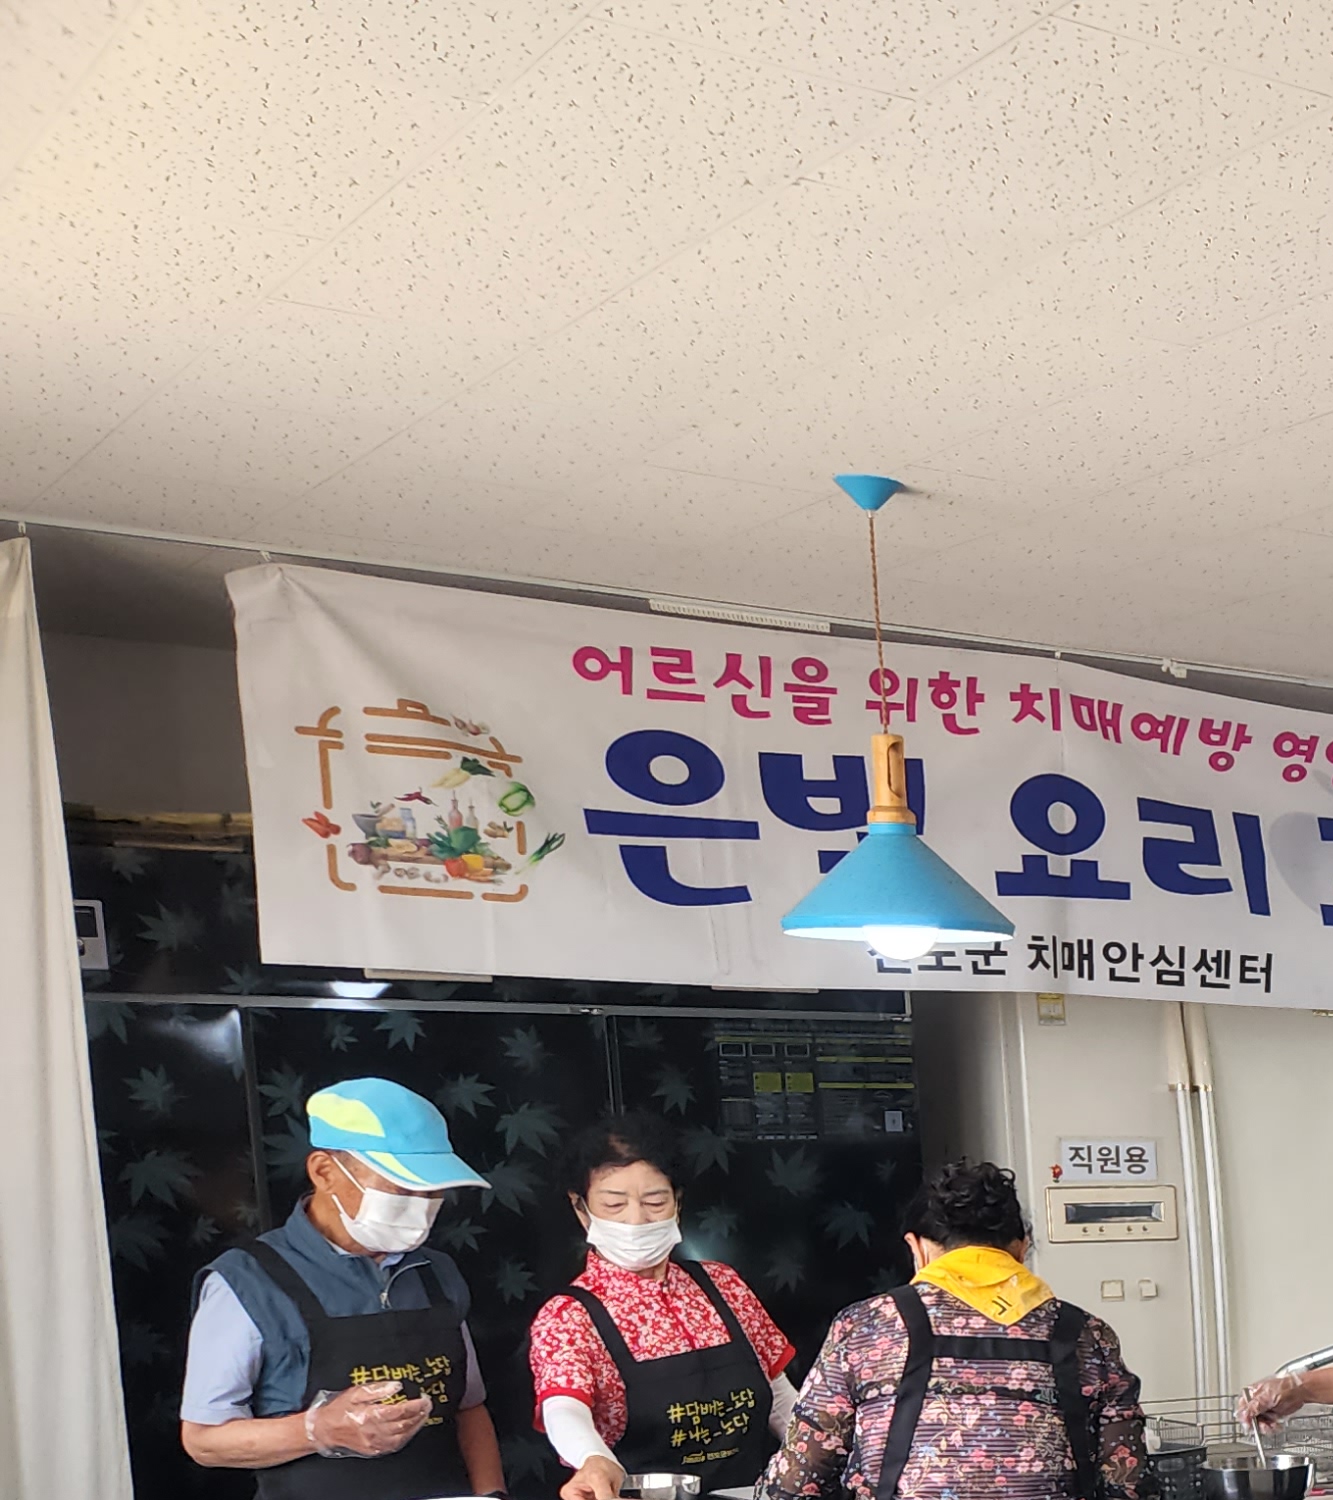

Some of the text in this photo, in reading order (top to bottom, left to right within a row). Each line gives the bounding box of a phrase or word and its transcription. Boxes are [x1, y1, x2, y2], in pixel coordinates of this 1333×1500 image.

[572, 645, 838, 726] 어르신을
[864, 667, 985, 736] 위한
[1009, 683, 1251, 773] 치매예방
[994, 773, 1271, 917] 요리
[1026, 934, 1274, 994] 치매안심센터
[1068, 1145, 1149, 1175] 직원용
